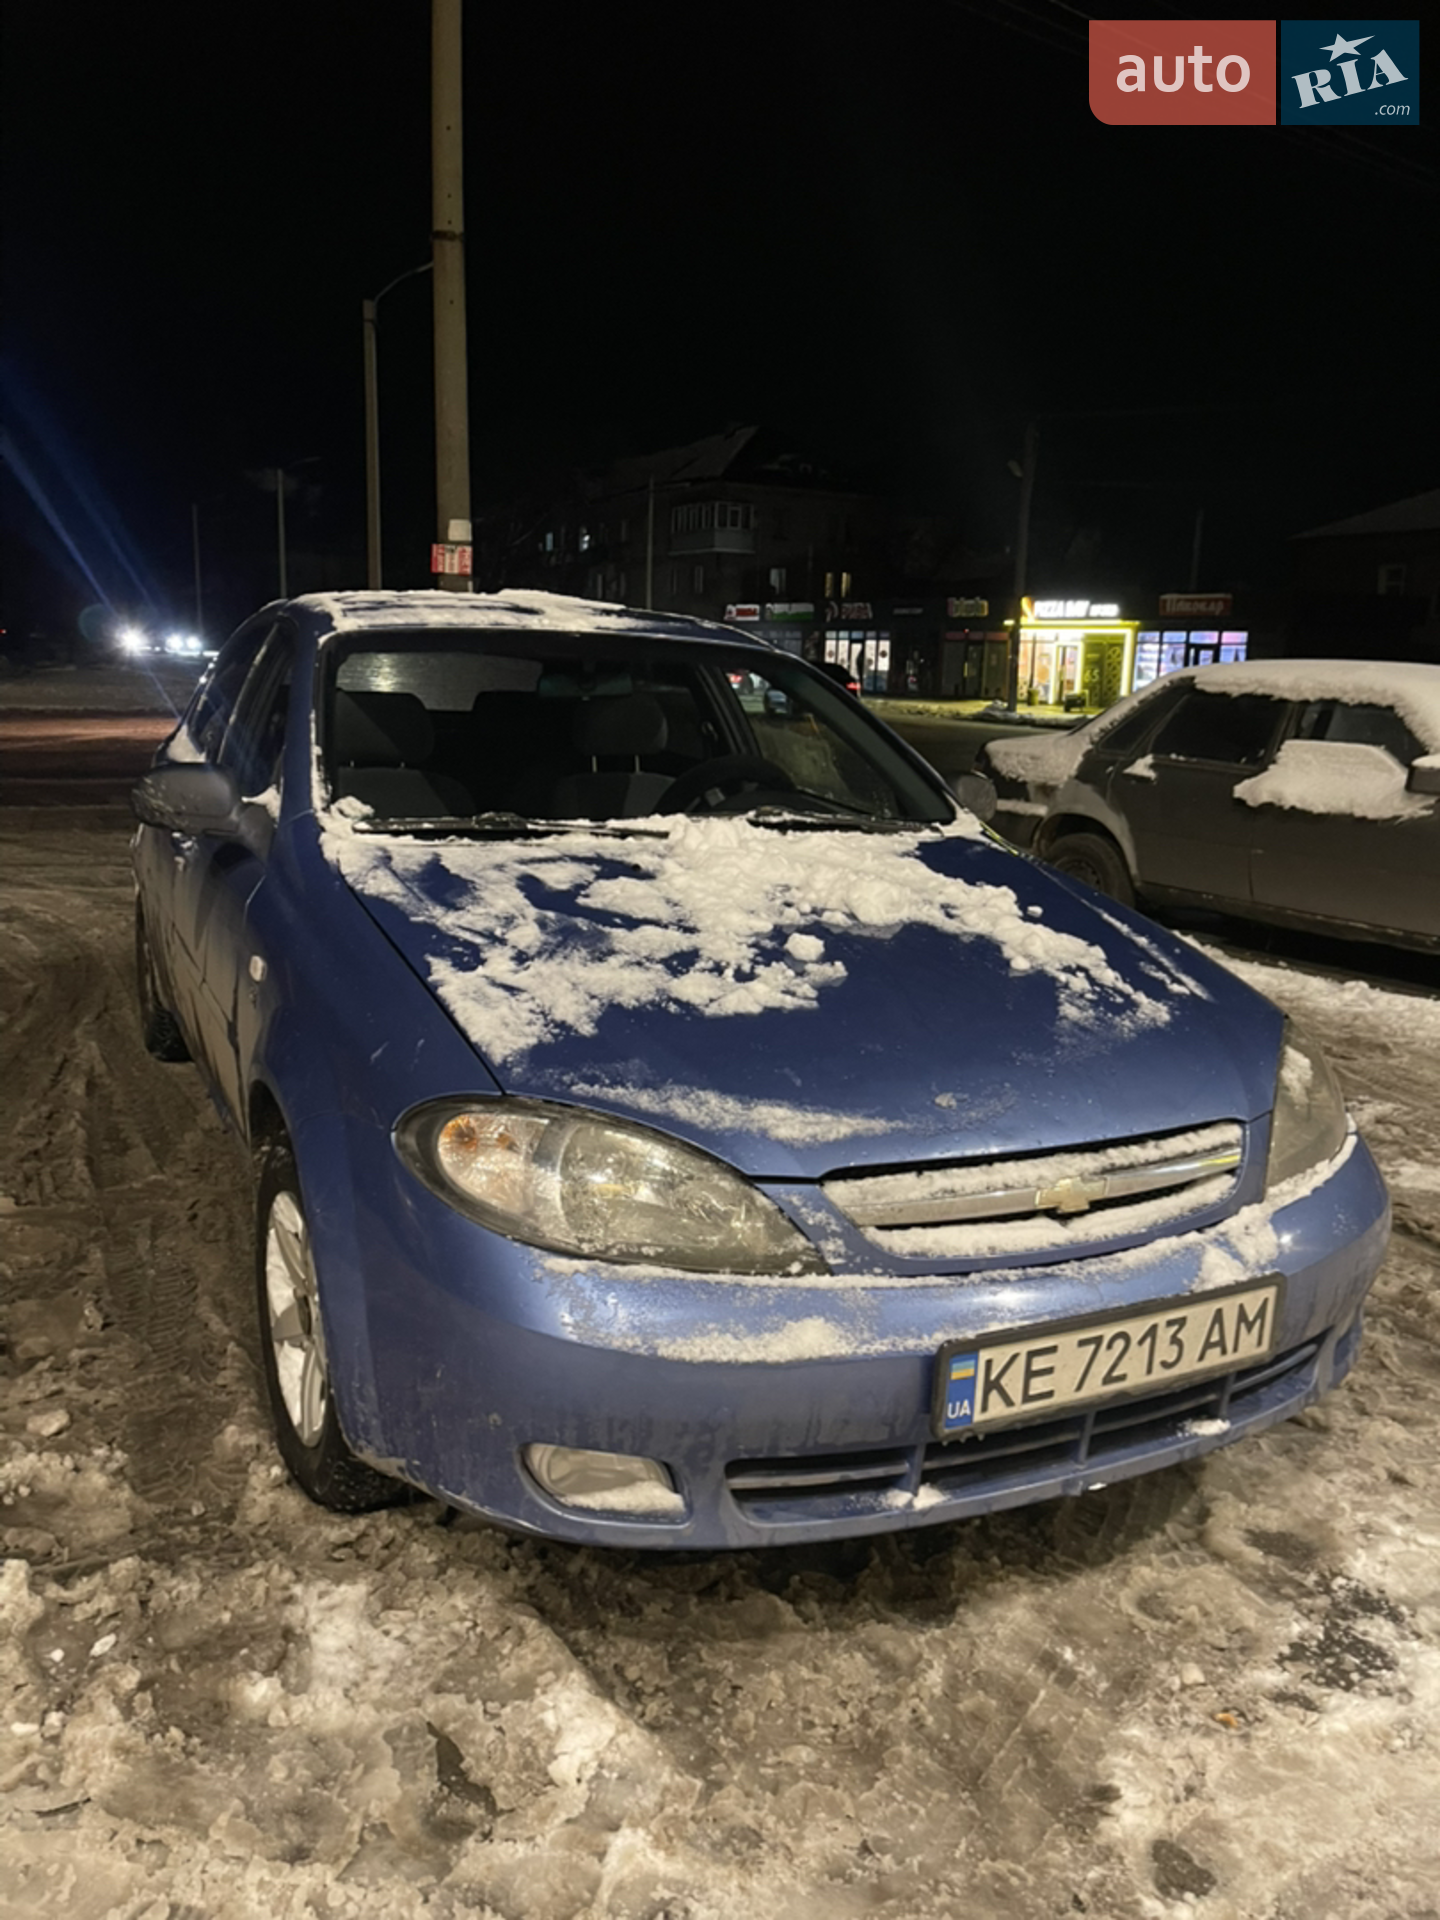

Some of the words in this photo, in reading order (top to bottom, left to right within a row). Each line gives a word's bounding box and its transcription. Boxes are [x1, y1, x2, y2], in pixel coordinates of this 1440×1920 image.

[980, 1345, 1059, 1414] KE
[1074, 1316, 1188, 1393] 7213
[1197, 1297, 1269, 1362] AM
[947, 1399, 971, 1419] UA
